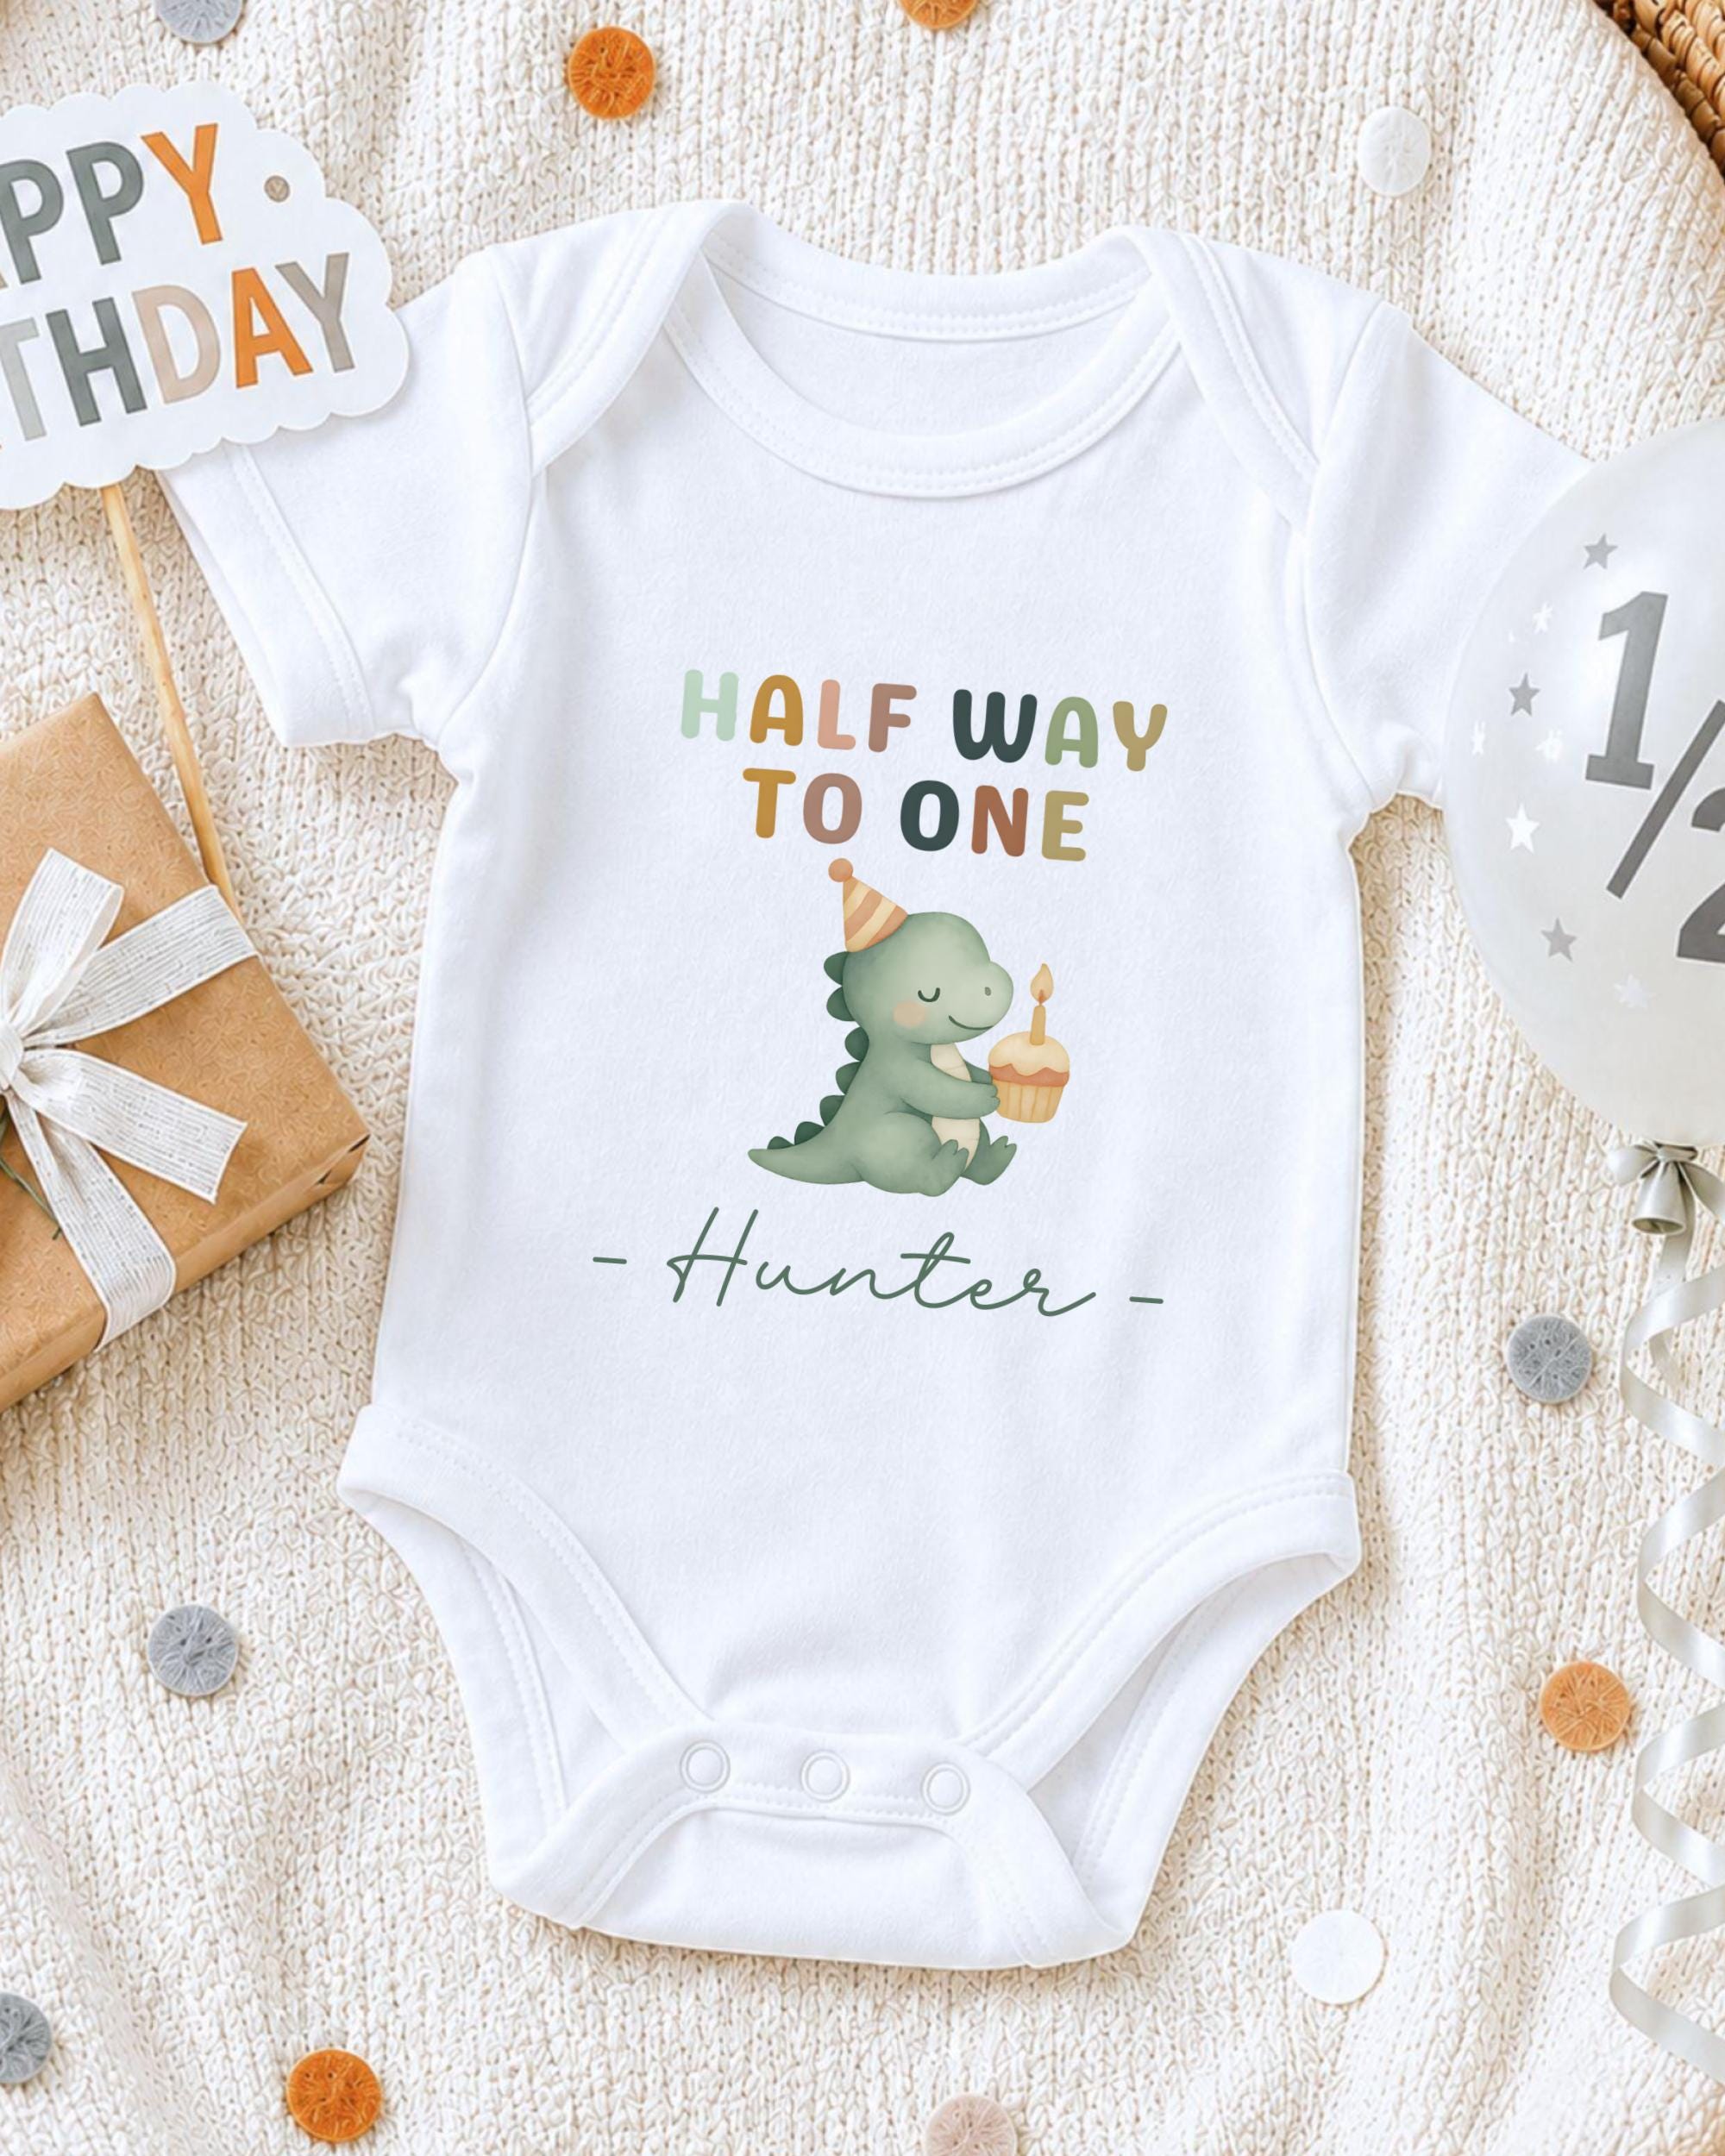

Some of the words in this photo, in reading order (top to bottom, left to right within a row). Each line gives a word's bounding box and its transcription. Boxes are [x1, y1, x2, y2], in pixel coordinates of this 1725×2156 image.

[0, 122, 223, 290] PPY
[0, 253, 354, 447] THDAY
[681, 670, 917, 753] HALF
[952, 689, 1168, 772] WAY
[742, 768, 862, 844] TO
[900, 780, 1089, 862] ONE
[666, 1206, 1097, 1317] Hunter
